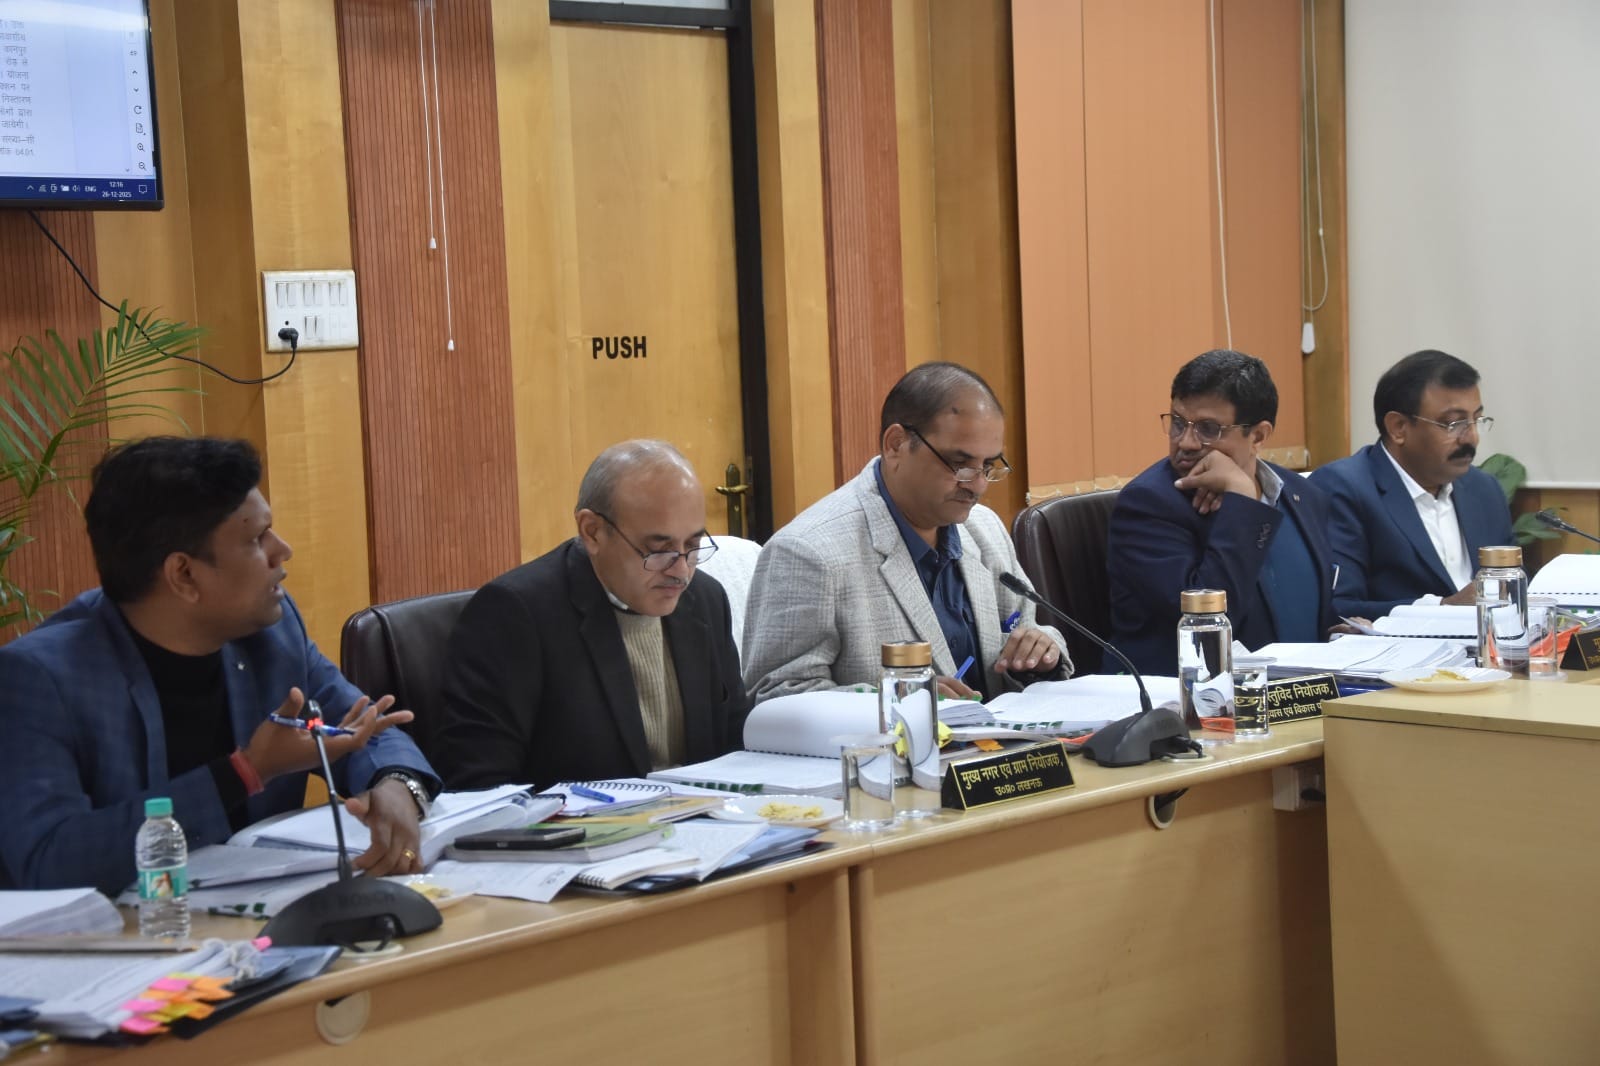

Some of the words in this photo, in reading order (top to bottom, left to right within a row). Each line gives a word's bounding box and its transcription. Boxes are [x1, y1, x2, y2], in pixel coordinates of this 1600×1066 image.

[592, 336, 646, 359] PUSH
[1283, 704, 1293, 718] एवं
[1293, 703, 1316, 714] विकास
[960, 769, 981, 791] मुख्य
[980, 766, 999, 781] नगर
[1000, 758, 1012, 780] एवं
[1012, 760, 1027, 775] ग्राम
[1016, 777, 1043, 792] लखनऊ
